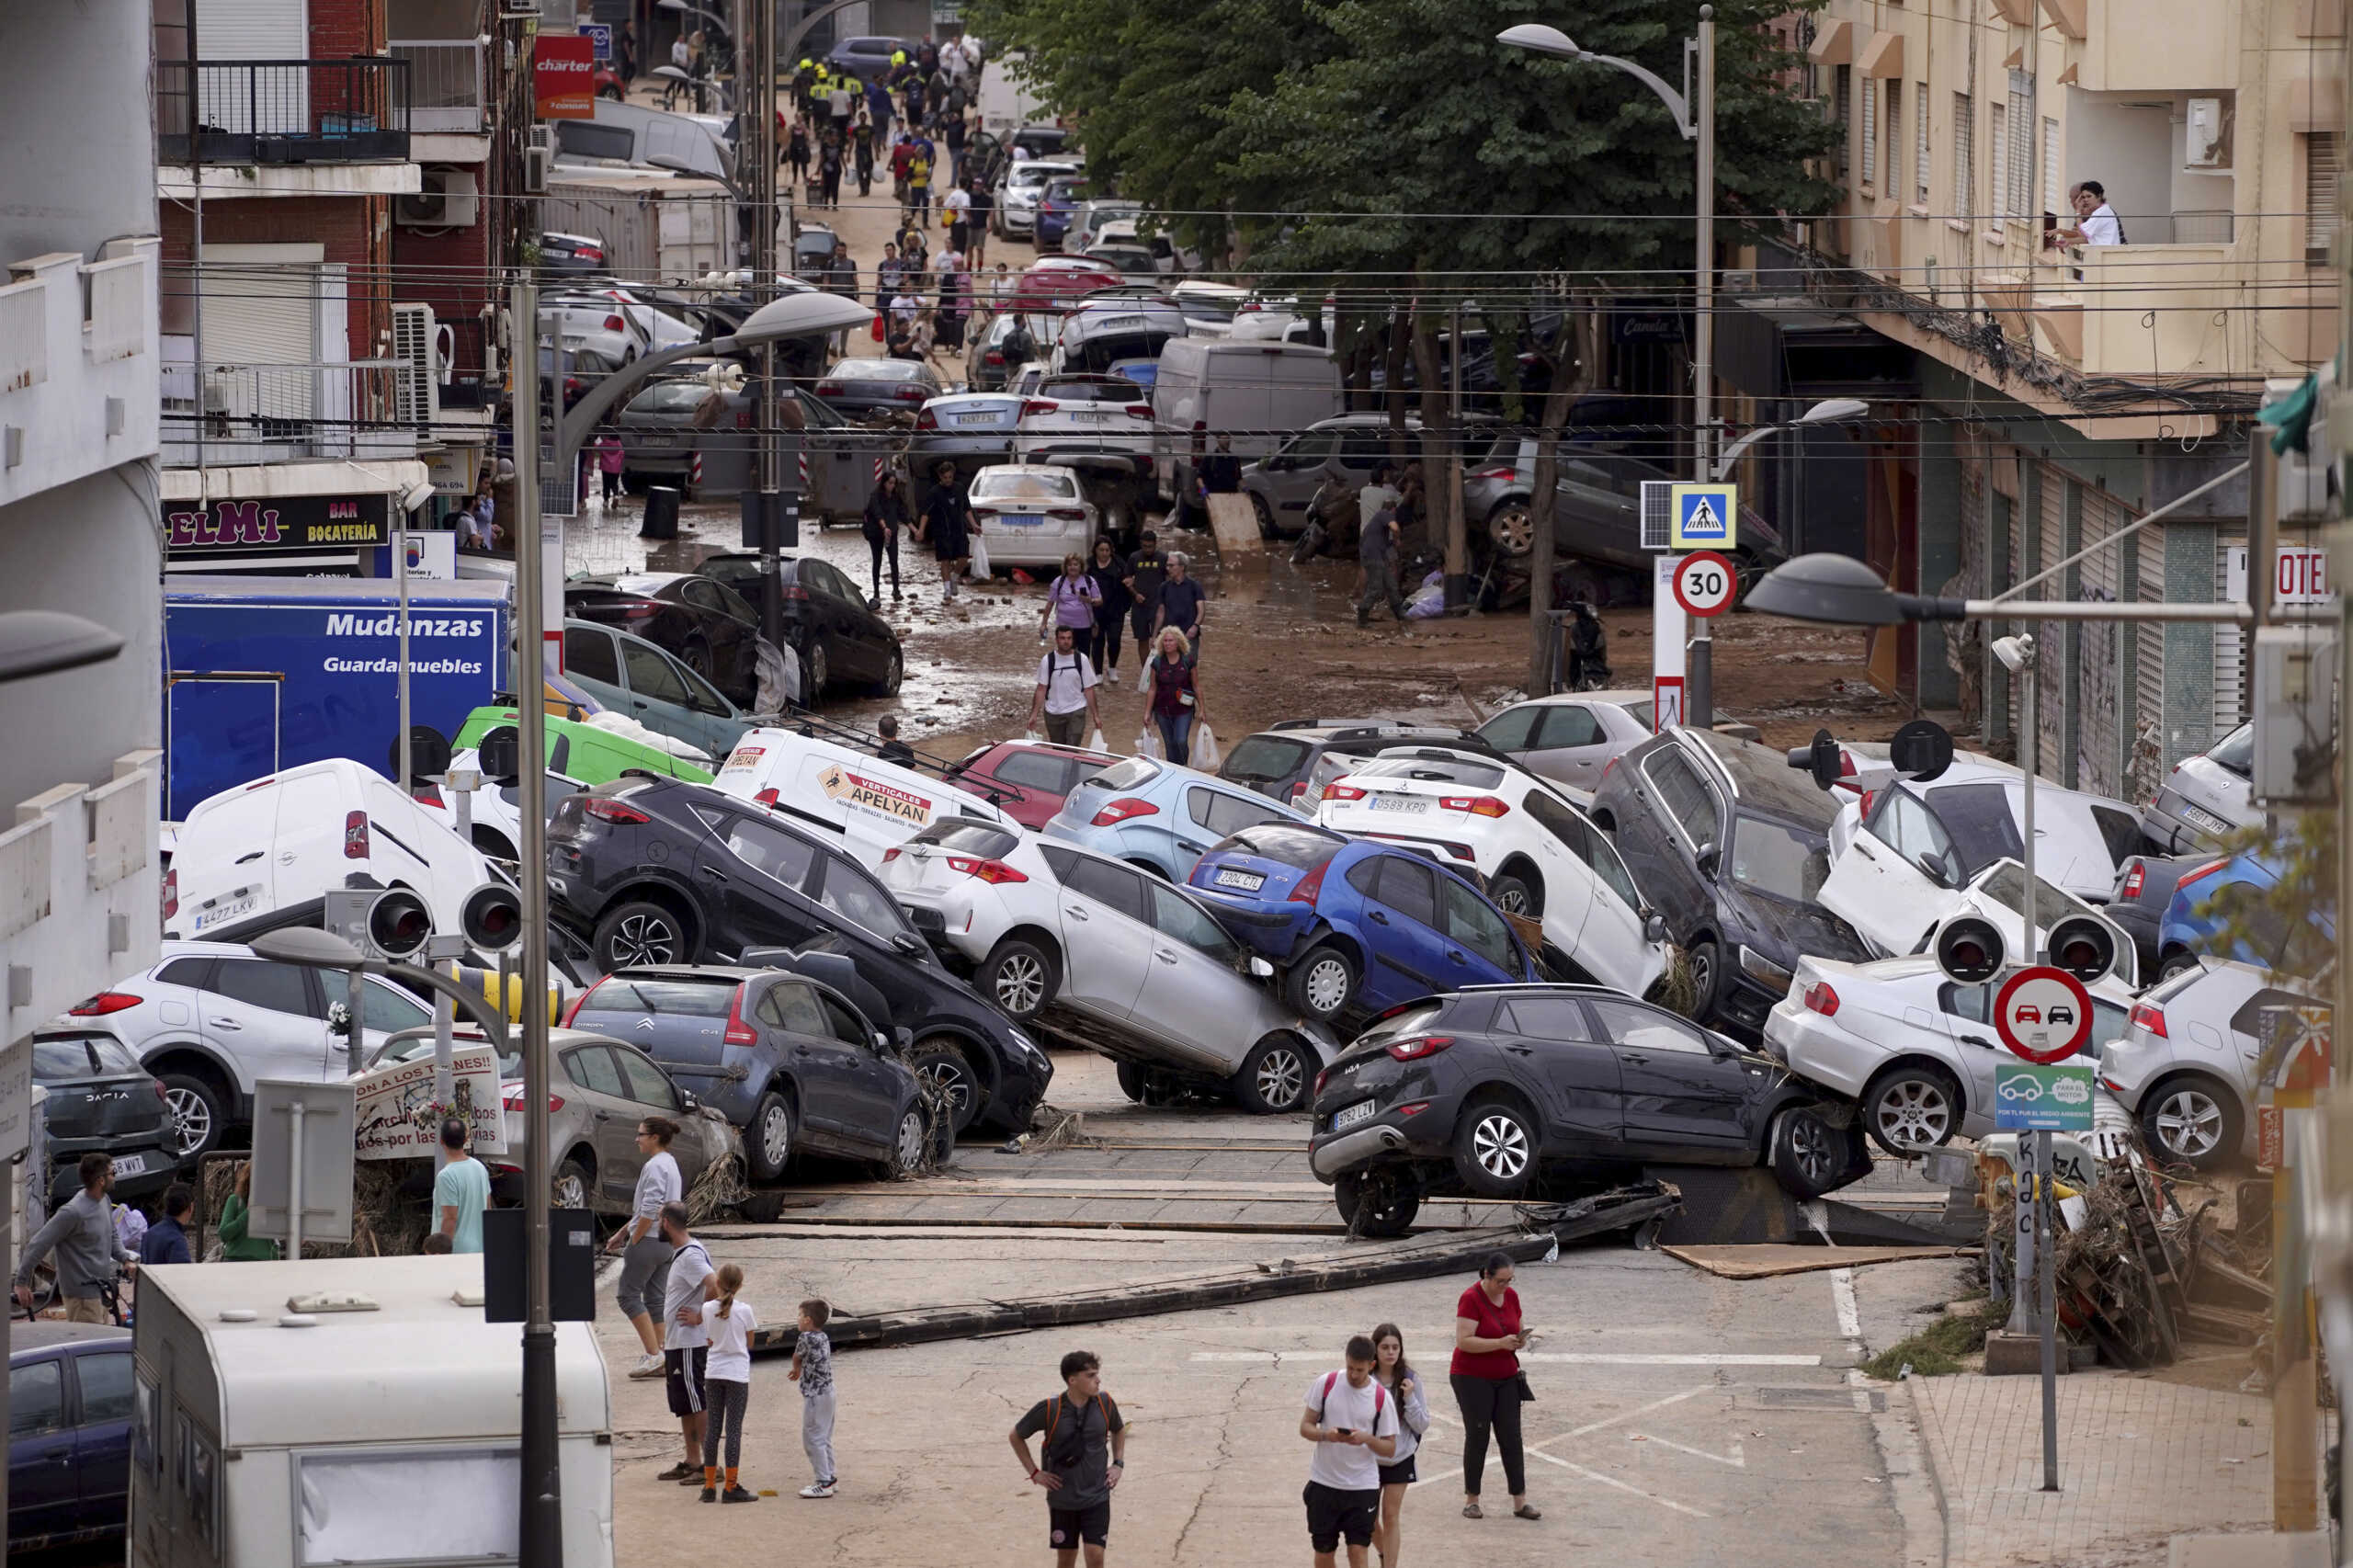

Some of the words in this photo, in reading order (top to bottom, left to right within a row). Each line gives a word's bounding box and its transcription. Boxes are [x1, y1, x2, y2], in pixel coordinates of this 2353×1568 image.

[537, 58, 592, 72] charter
[329, 503, 358, 518] BAR
[307, 521, 378, 542] BOCATERÍA
[1689, 572, 1722, 596] 30
[861, 778, 922, 805] VERTICALES
[851, 788, 925, 822] APELYAN
[1221, 872, 1241, 883] 2304
[1243, 876, 1258, 889] CTL
[381, 1079, 391, 1088] A
[393, 1068, 424, 1084] LOS
[85, 1091, 129, 1102] DACIA
[387, 1133, 413, 1149] por
